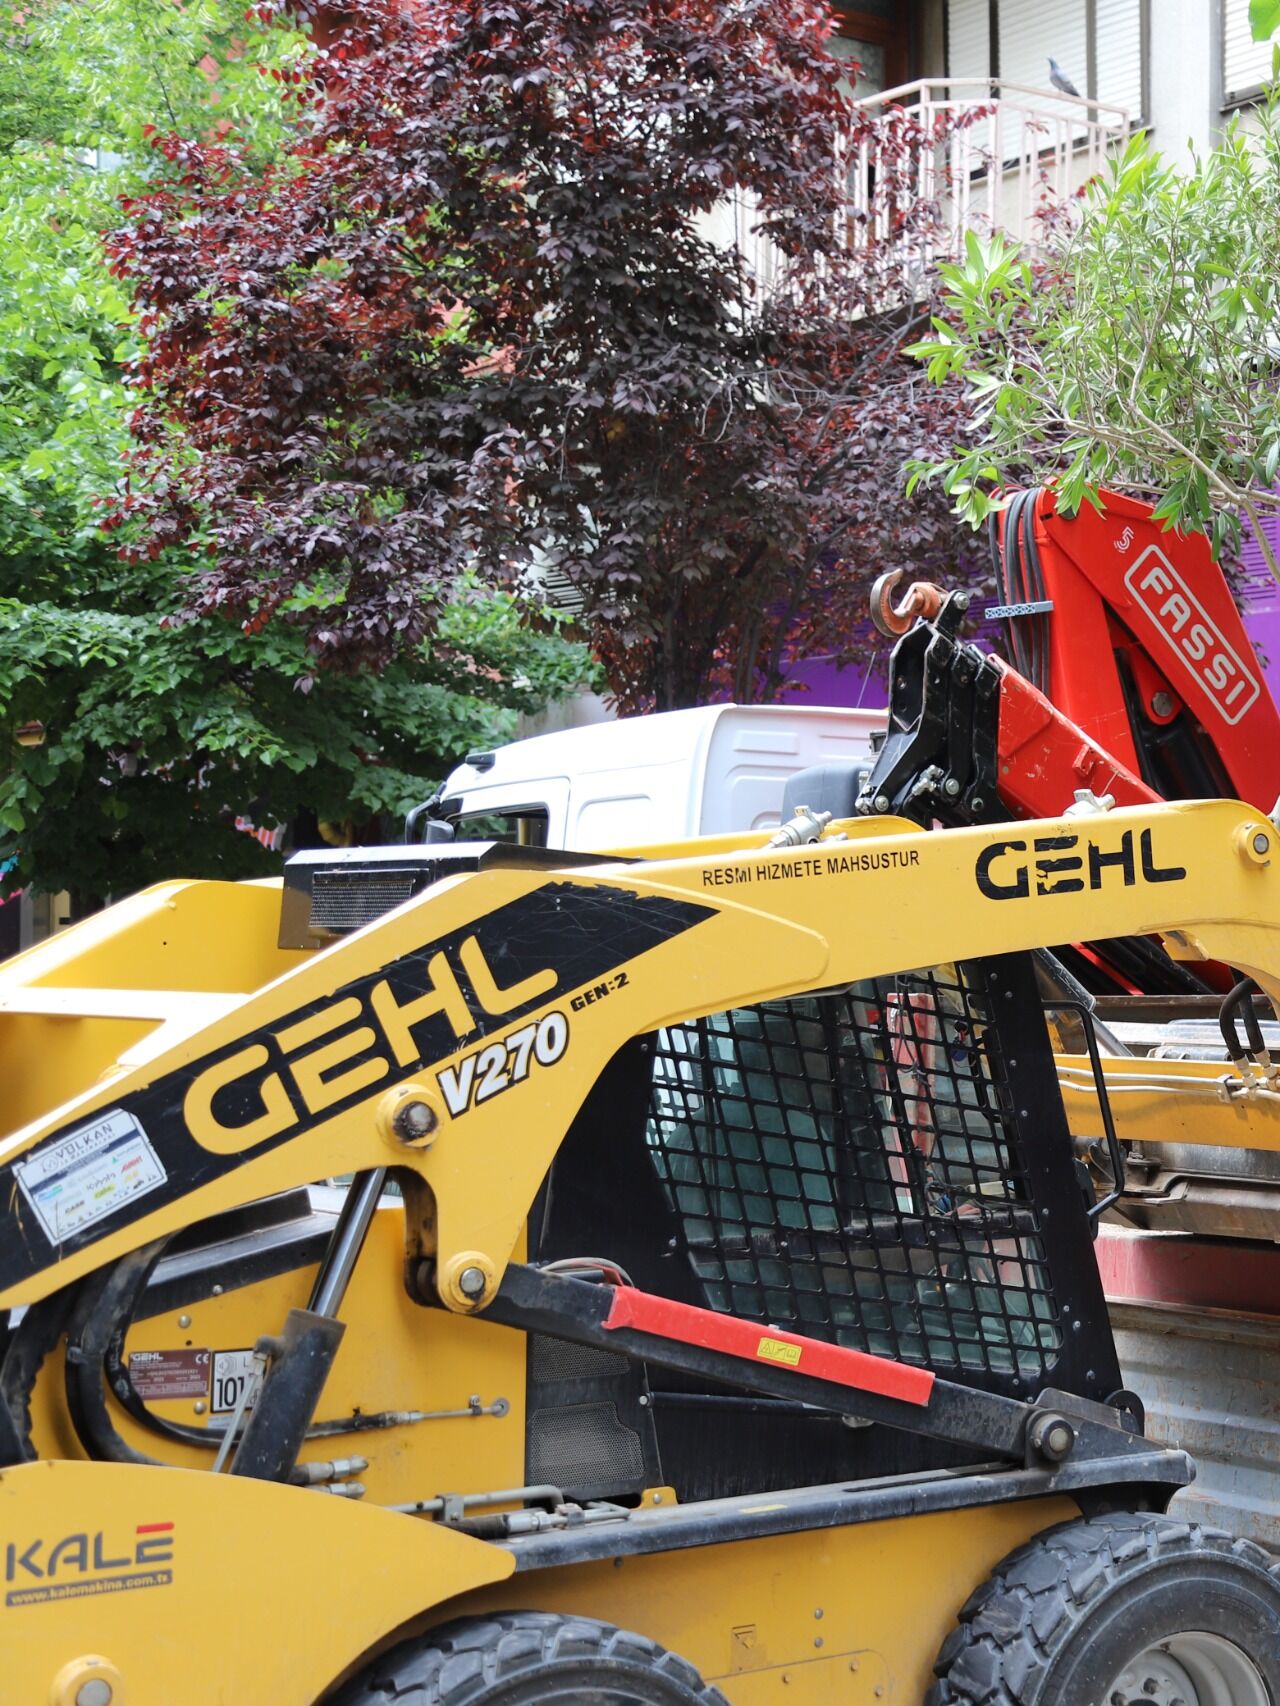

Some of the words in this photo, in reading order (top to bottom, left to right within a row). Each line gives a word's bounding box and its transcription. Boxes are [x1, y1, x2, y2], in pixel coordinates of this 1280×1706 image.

[1140, 566, 1245, 705] FASSI
[757, 859, 822, 881] HIZMETE
[827, 850, 920, 875] MAHSUSTUR
[975, 828, 1187, 900] GEHL
[183, 934, 559, 1155] GEHL
[437, 1010, 569, 1119] V270
[56, 1123, 113, 1158] VOLKAN
[132, 1352, 164, 1361] GEHL
[6, 1522, 174, 1582] KALE
